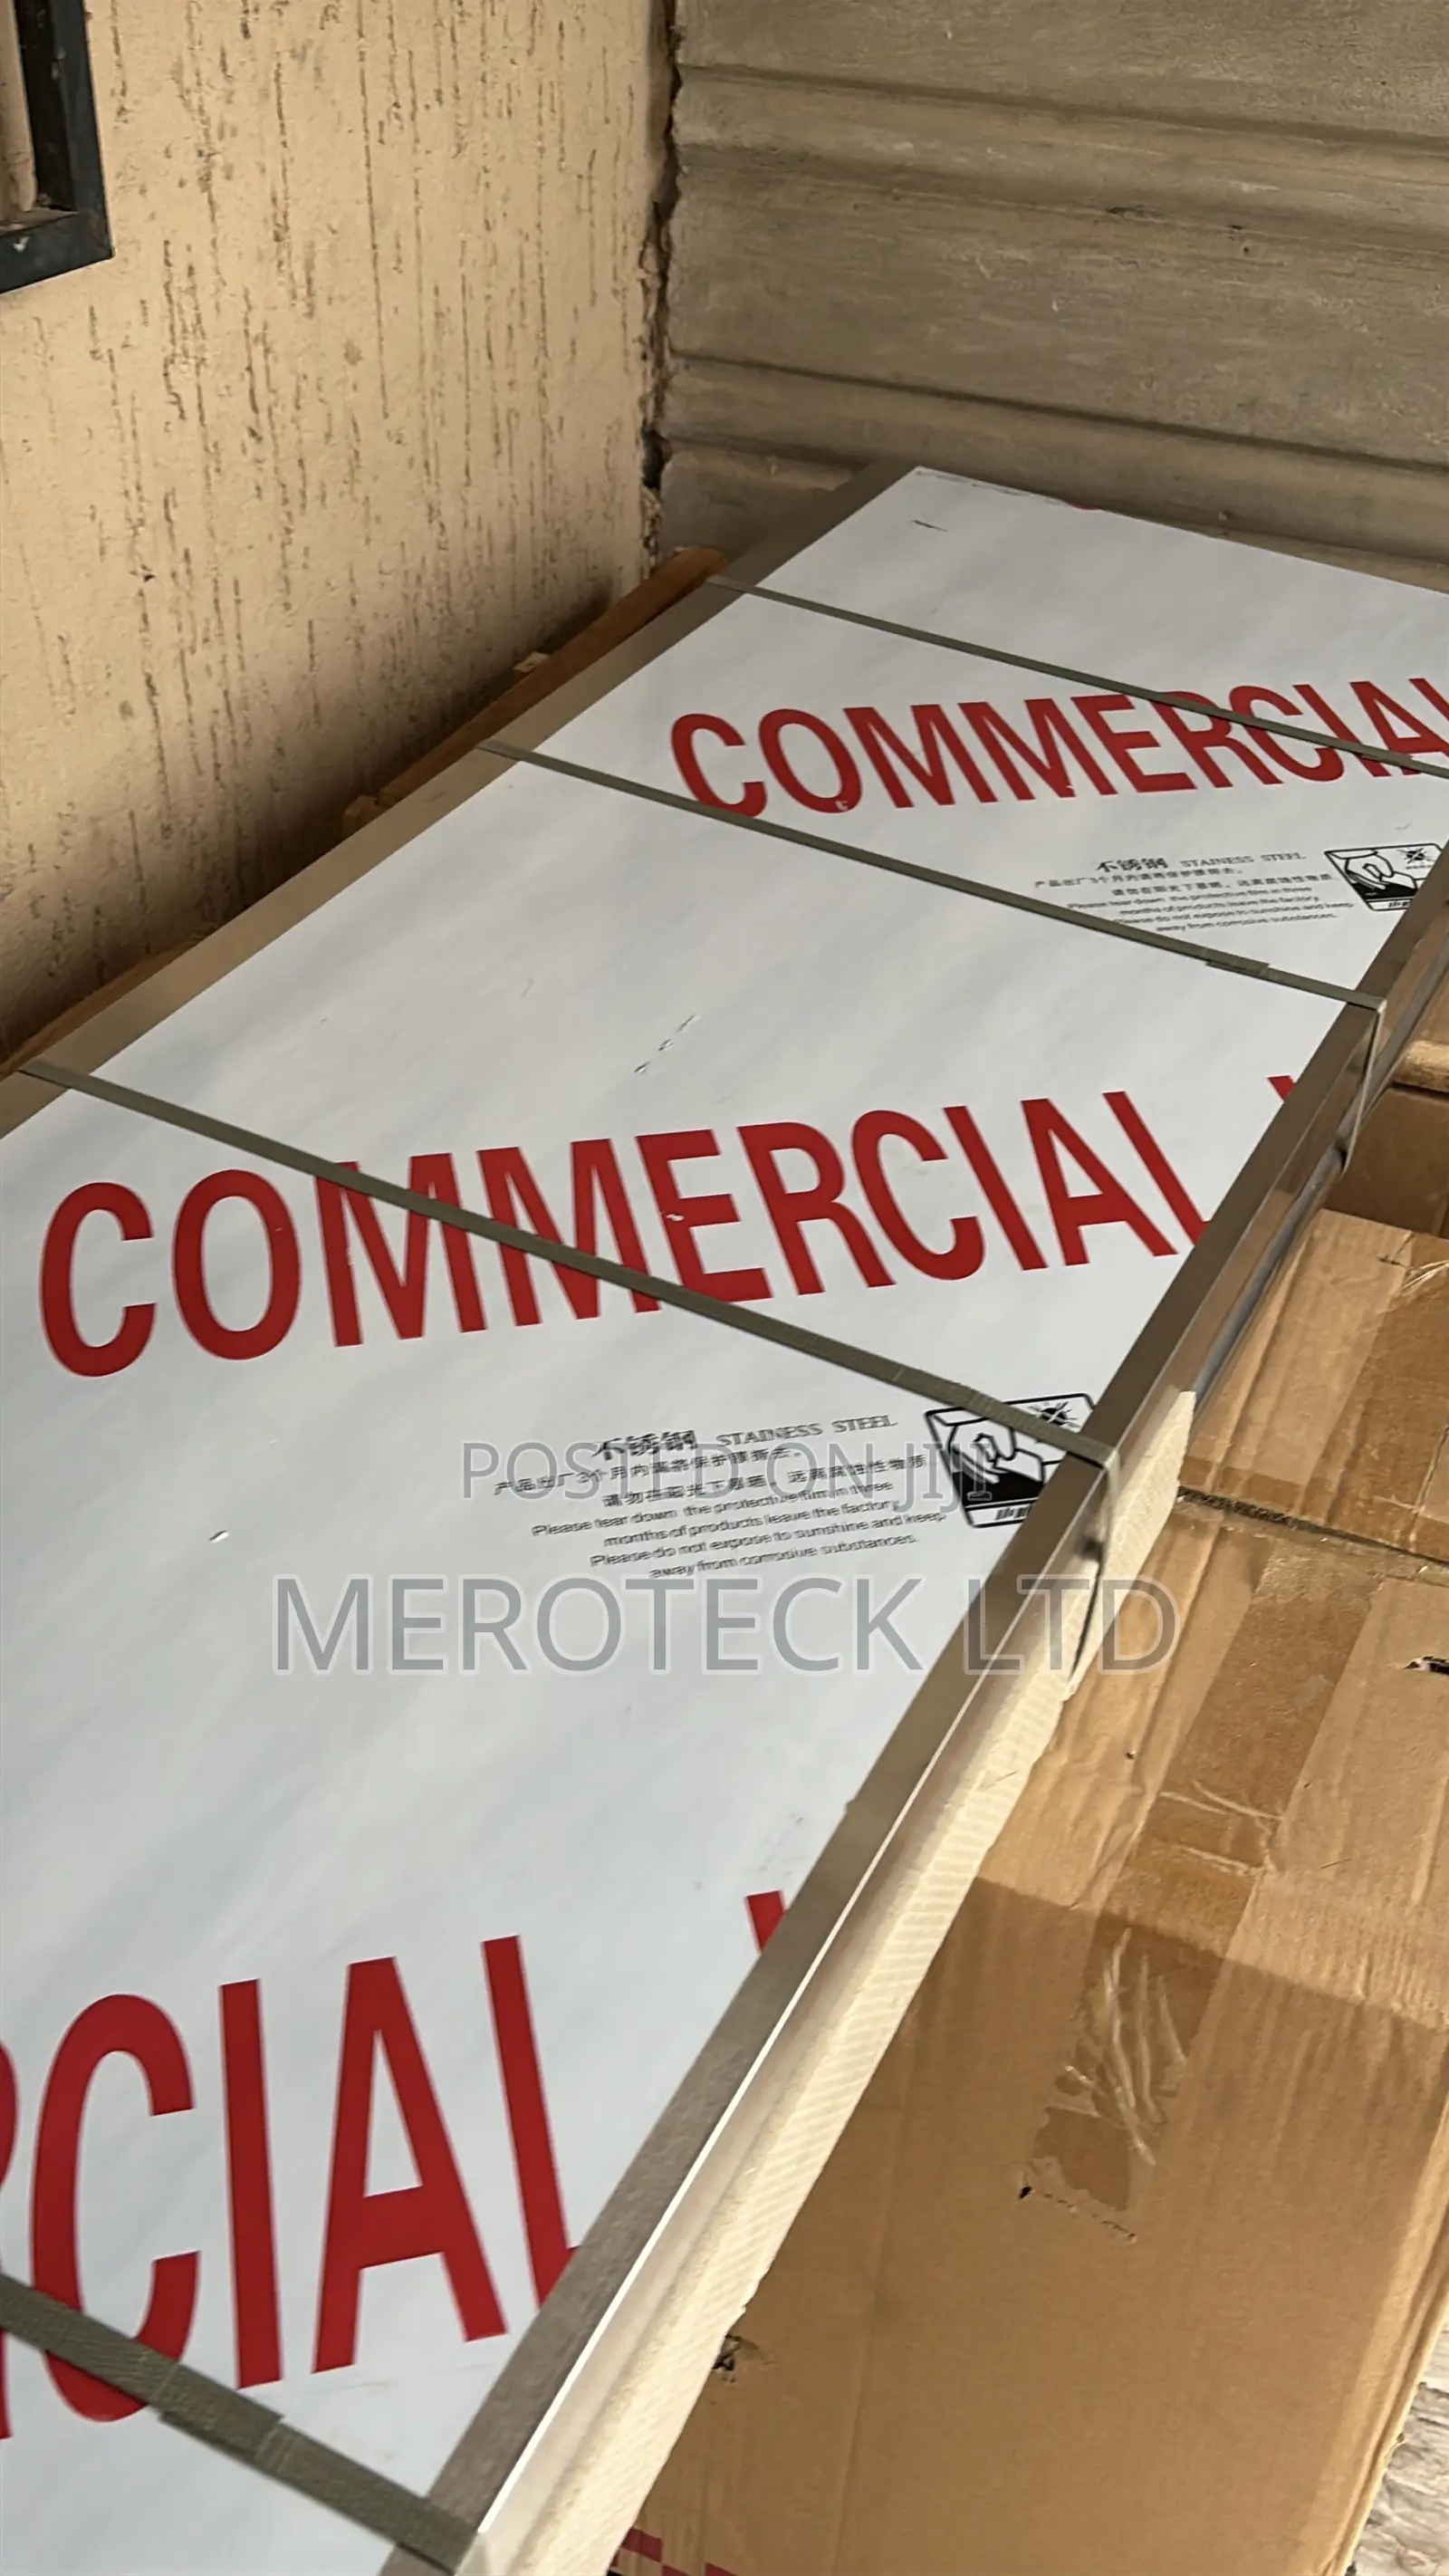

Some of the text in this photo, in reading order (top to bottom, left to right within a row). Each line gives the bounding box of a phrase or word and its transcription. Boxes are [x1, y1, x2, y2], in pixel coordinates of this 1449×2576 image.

[39, 1091, 1212, 1378] COMMERCIAL
[591, 1429, 698, 1461] 不锈钢
[715, 1415, 898, 1447] STAINESS STEEL
[532, 1519, 592, 1536] Please
[593, 1515, 629, 1529] tear
[629, 1508, 678, 1524] down
[683, 1503, 712, 1517] the
[713, 1490, 801, 1515] protective
[603, 1529, 668, 1547] months
[668, 1524, 688, 1539] of
[688, 1515, 763, 1538] products
[763, 1509, 811, 1525] leave
[811, 1504, 840, 1520] the
[590, 1511, 947, 1568] Please do not expose to sunshine and keep
[648, 1562, 696, 1579] away
[696, 1556, 739, 1572] from
[739, 1547, 818, 1567] corrosive
[0, 1935, 581, 2440] CIAL
